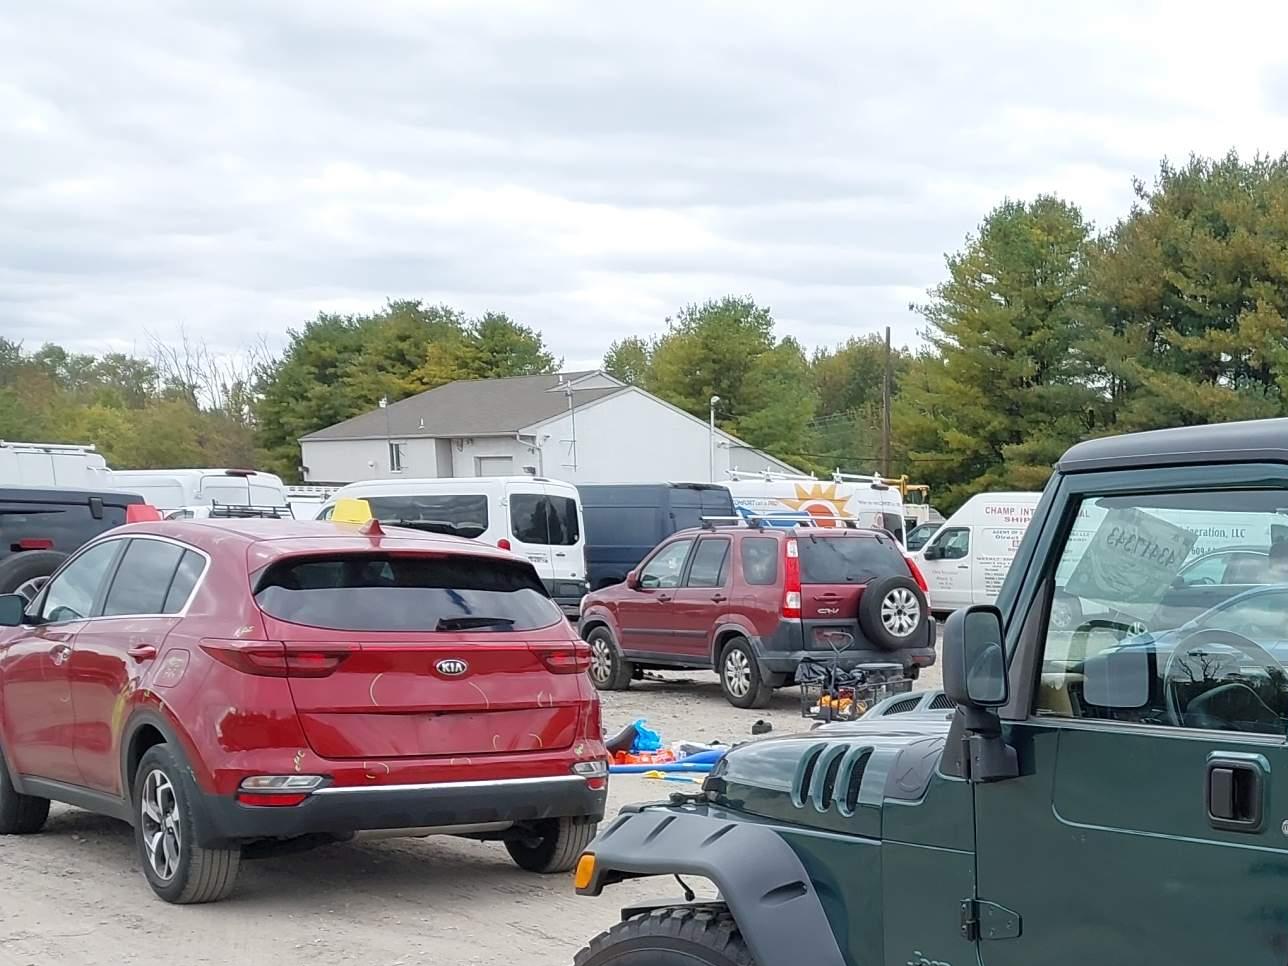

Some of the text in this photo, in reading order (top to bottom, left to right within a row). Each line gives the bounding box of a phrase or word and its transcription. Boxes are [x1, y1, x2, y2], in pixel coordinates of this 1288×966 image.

[985, 506, 1015, 515] CHAMP
[1020, 508, 1036, 516] INT
[1231, 528, 1247, 538] LLC
[441, 662, 463, 673] KIA
